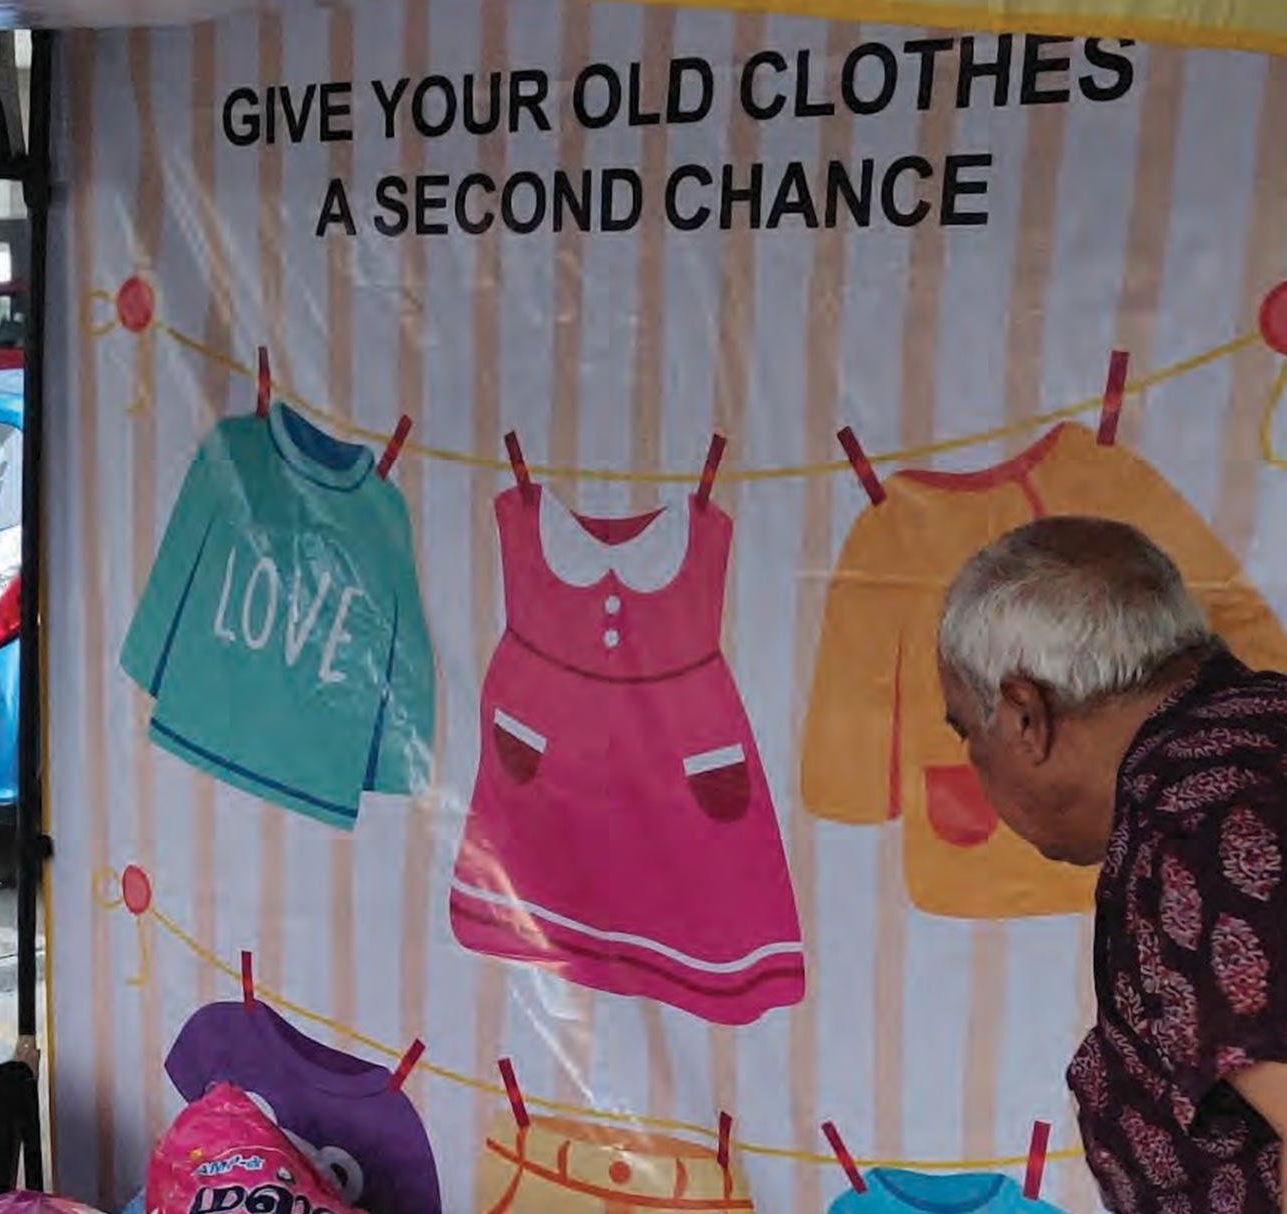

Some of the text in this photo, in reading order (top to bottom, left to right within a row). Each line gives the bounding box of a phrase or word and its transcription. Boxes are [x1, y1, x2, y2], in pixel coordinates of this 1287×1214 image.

[222, 36, 1136, 145] GIVE YOUR OLD CLOTHES
[316, 154, 993, 237] A SECOND CHANCE
[214, 547, 364, 682] LOVE
